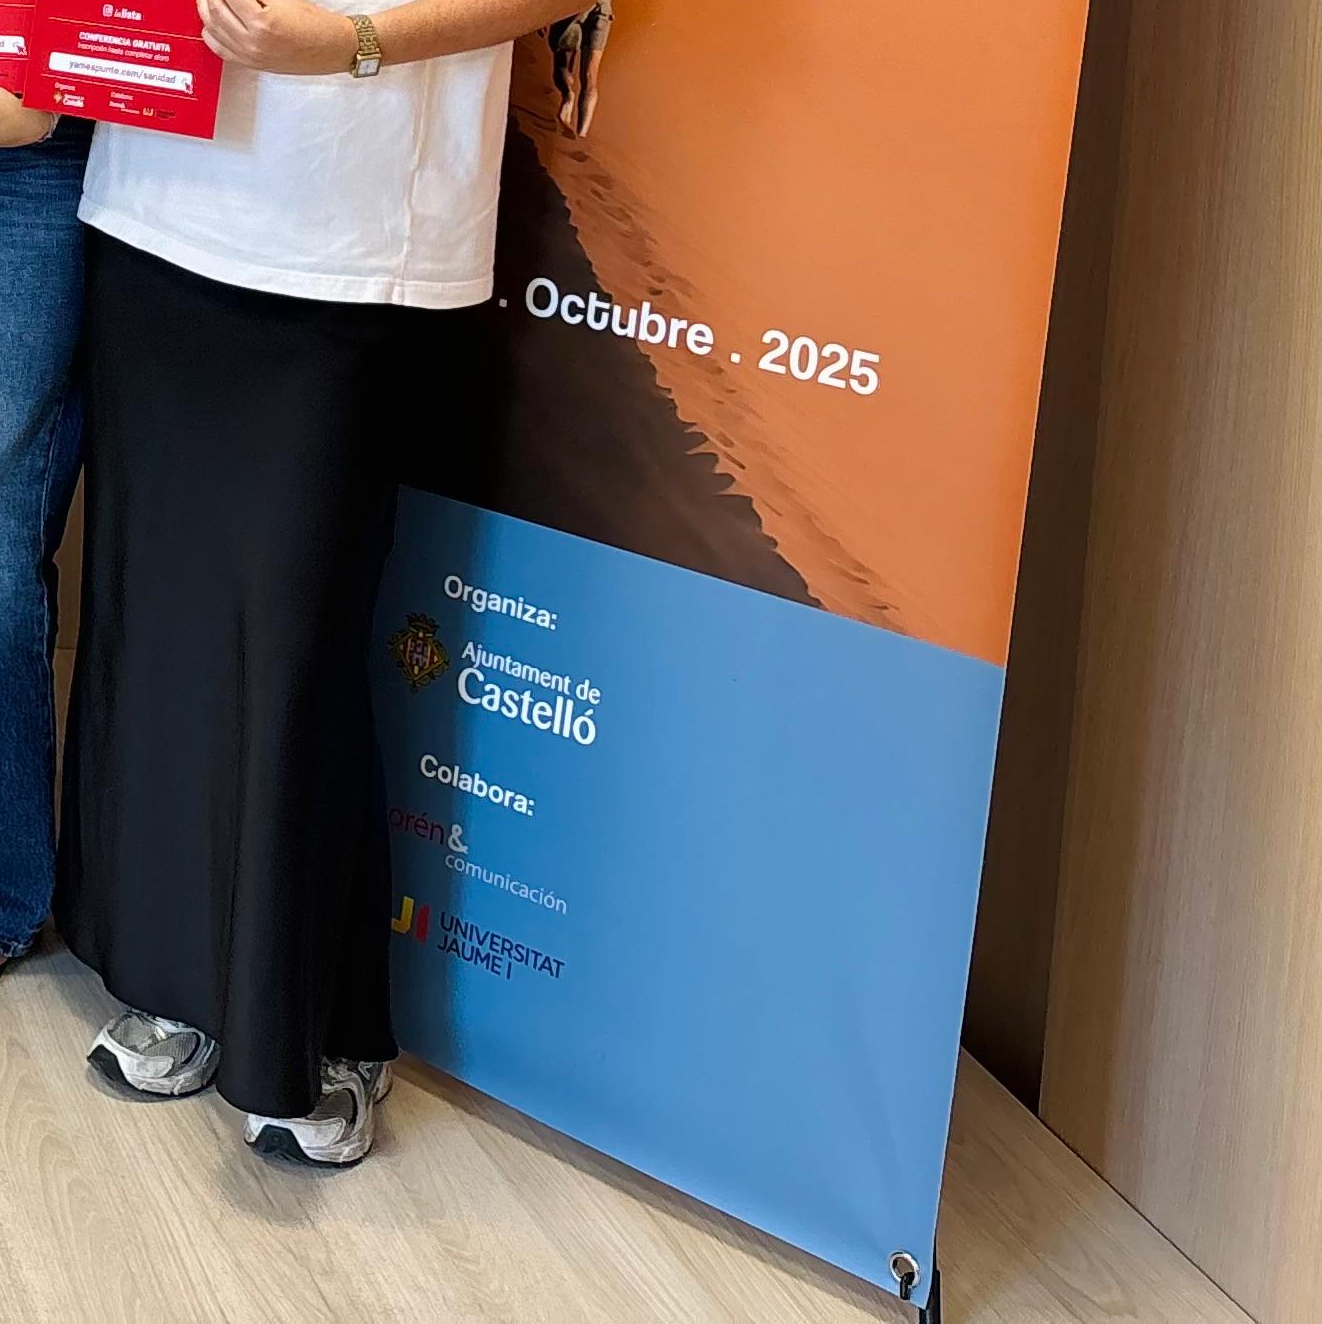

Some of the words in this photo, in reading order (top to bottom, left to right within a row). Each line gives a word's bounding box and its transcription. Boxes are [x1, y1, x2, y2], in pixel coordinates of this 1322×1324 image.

[526, 276, 716, 356] Octubre
[759, 330, 879, 395] 2025
[443, 574, 558, 631] Organiza:
[460, 641, 571, 696] Ajuntament
[575, 678, 601, 705] de
[456, 666, 596, 746] Castelló
[419, 754, 536, 816] Colabora:
[444, 853, 568, 915] comunicación
[436, 938, 503, 975] JAUME
[439, 911, 565, 979] UNIVERSITAT
